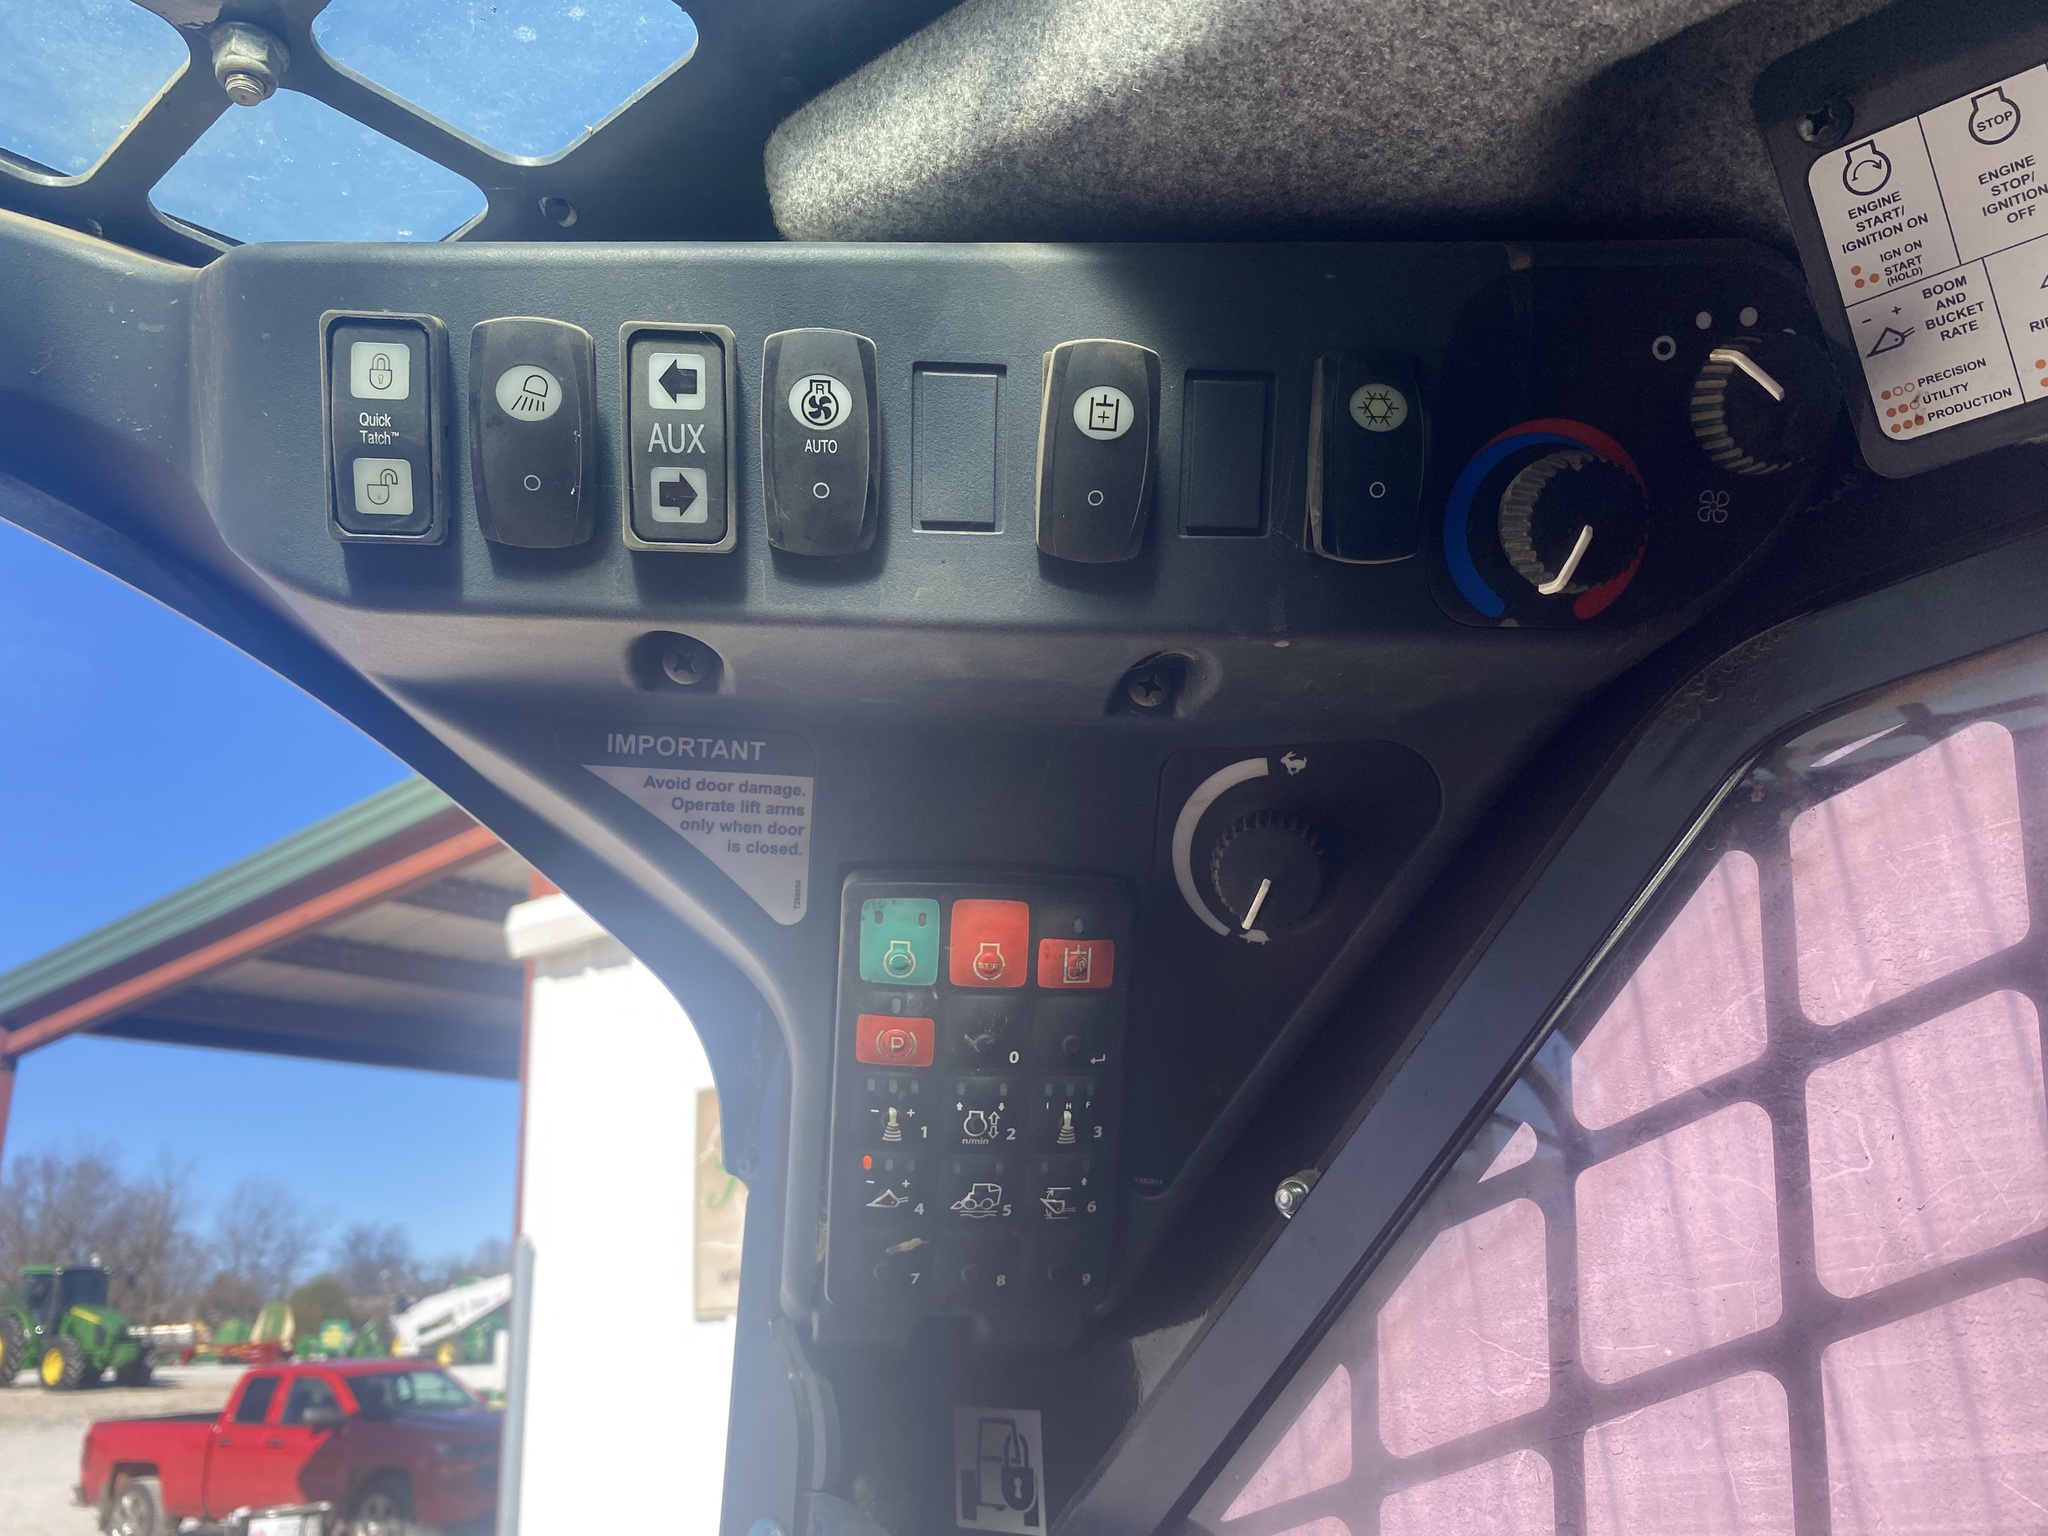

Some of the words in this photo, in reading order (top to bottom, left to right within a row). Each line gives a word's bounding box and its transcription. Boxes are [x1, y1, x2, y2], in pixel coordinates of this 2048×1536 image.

[1976, 109, 2014, 133] STOP
[1978, 154, 2036, 185] ENGINE
[1991, 171, 2035, 197] STOP/
[1847, 191, 1902, 220] ENGINE
[1982, 183, 2048, 216] IGNITION
[1855, 206, 1906, 233] START/
[2006, 204, 2036, 223] OFF
[1841, 222, 1904, 254] IGNITION
[1901, 213, 1929, 233] ON
[1880, 245, 1902, 263] IGN
[1904, 239, 1923, 256] ON
[1884, 255, 1923, 277] START
[1887, 266, 1924, 287] (HOLD)
[1922, 275, 1968, 300] BOOM
[1935, 291, 1967, 311] AND
[1924, 301, 1986, 332] BUCKET
[1940, 320, 1980, 342] RATE
[1917, 357, 1988, 388] PRECISION
[815, 382, 826, 395] R
[1922, 382, 1970, 405] UTILITY
[1927, 387, 2013, 422] PRODUCTION
[359, 411, 392, 429] Quick
[648, 423, 706, 454] AUX
[804, 438, 838, 454] AUTO
[607, 733, 766, 761] IMPORTANT
[643, 775, 691, 790] Avoid
[695, 777, 735, 792] door
[738, 781, 806, 799] damage.
[671, 797, 736, 813] Operate
[740, 799, 761, 814] lift
[765, 803, 805, 817] arms
[680, 818, 715, 834] only
[720, 820, 762, 834] when
[767, 822, 804, 836] door
[727, 840, 741, 852] is
[746, 841, 803, 856] closed.
[978, 962, 1001, 970] STOP
[890, 1036, 905, 1052] P
[1008, 1050, 1020, 1064] 0
[920, 1126, 928, 1139] 1
[1006, 1127, 1016, 1141] 2
[1093, 1125, 1103, 1138] 3
[913, 1203, 925, 1216] 4
[1002, 1204, 1012, 1217] 5
[1087, 1201, 1097, 1213] 6
[910, 1273, 920, 1285] 7
[996, 1273, 1006, 1287] 8
[1082, 1273, 1091, 1285] 9
